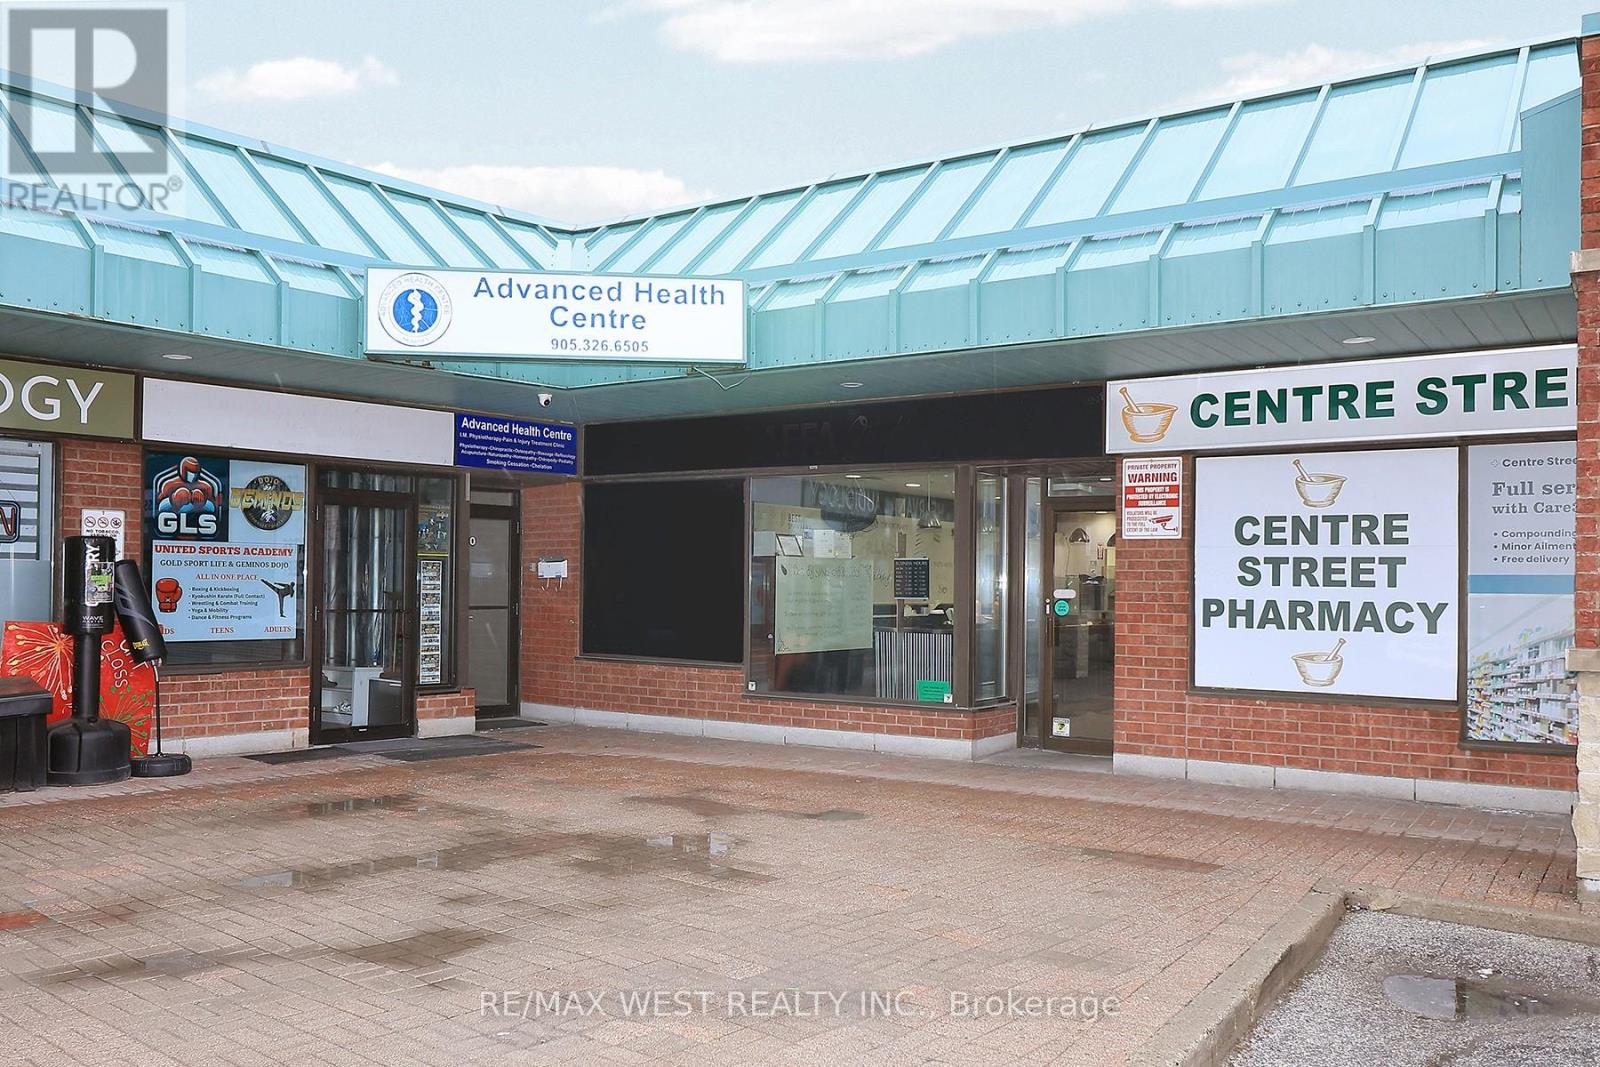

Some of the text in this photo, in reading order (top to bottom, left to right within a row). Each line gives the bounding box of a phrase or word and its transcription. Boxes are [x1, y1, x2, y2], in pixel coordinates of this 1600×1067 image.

[473, 277, 725, 305] Advanced Health
[550, 305, 646, 330] Centre
[551, 338, 649, 353] 905.326.6505
[1190, 367, 1578, 429] CENTRE STRE
[461, 417, 573, 441] Advanced Health Centre
[1502, 458, 1544, 467] Centre
[1128, 472, 1177, 483] WARNING
[1492, 481, 1535, 497] Full
[1492, 502, 1528, 515] with
[157, 512, 217, 535] GLS
[1234, 514, 1410, 547] CENTRE
[155, 545, 293, 556] UNITED SPORTS ACADEMY
[1501, 542, 1532, 551] Minor
[271, 561, 289, 569] DOJO
[1501, 555, 1570, 565] Free delivery
[1237, 556, 1407, 588] STREET
[1202, 598, 1448, 635] PHARMACY
